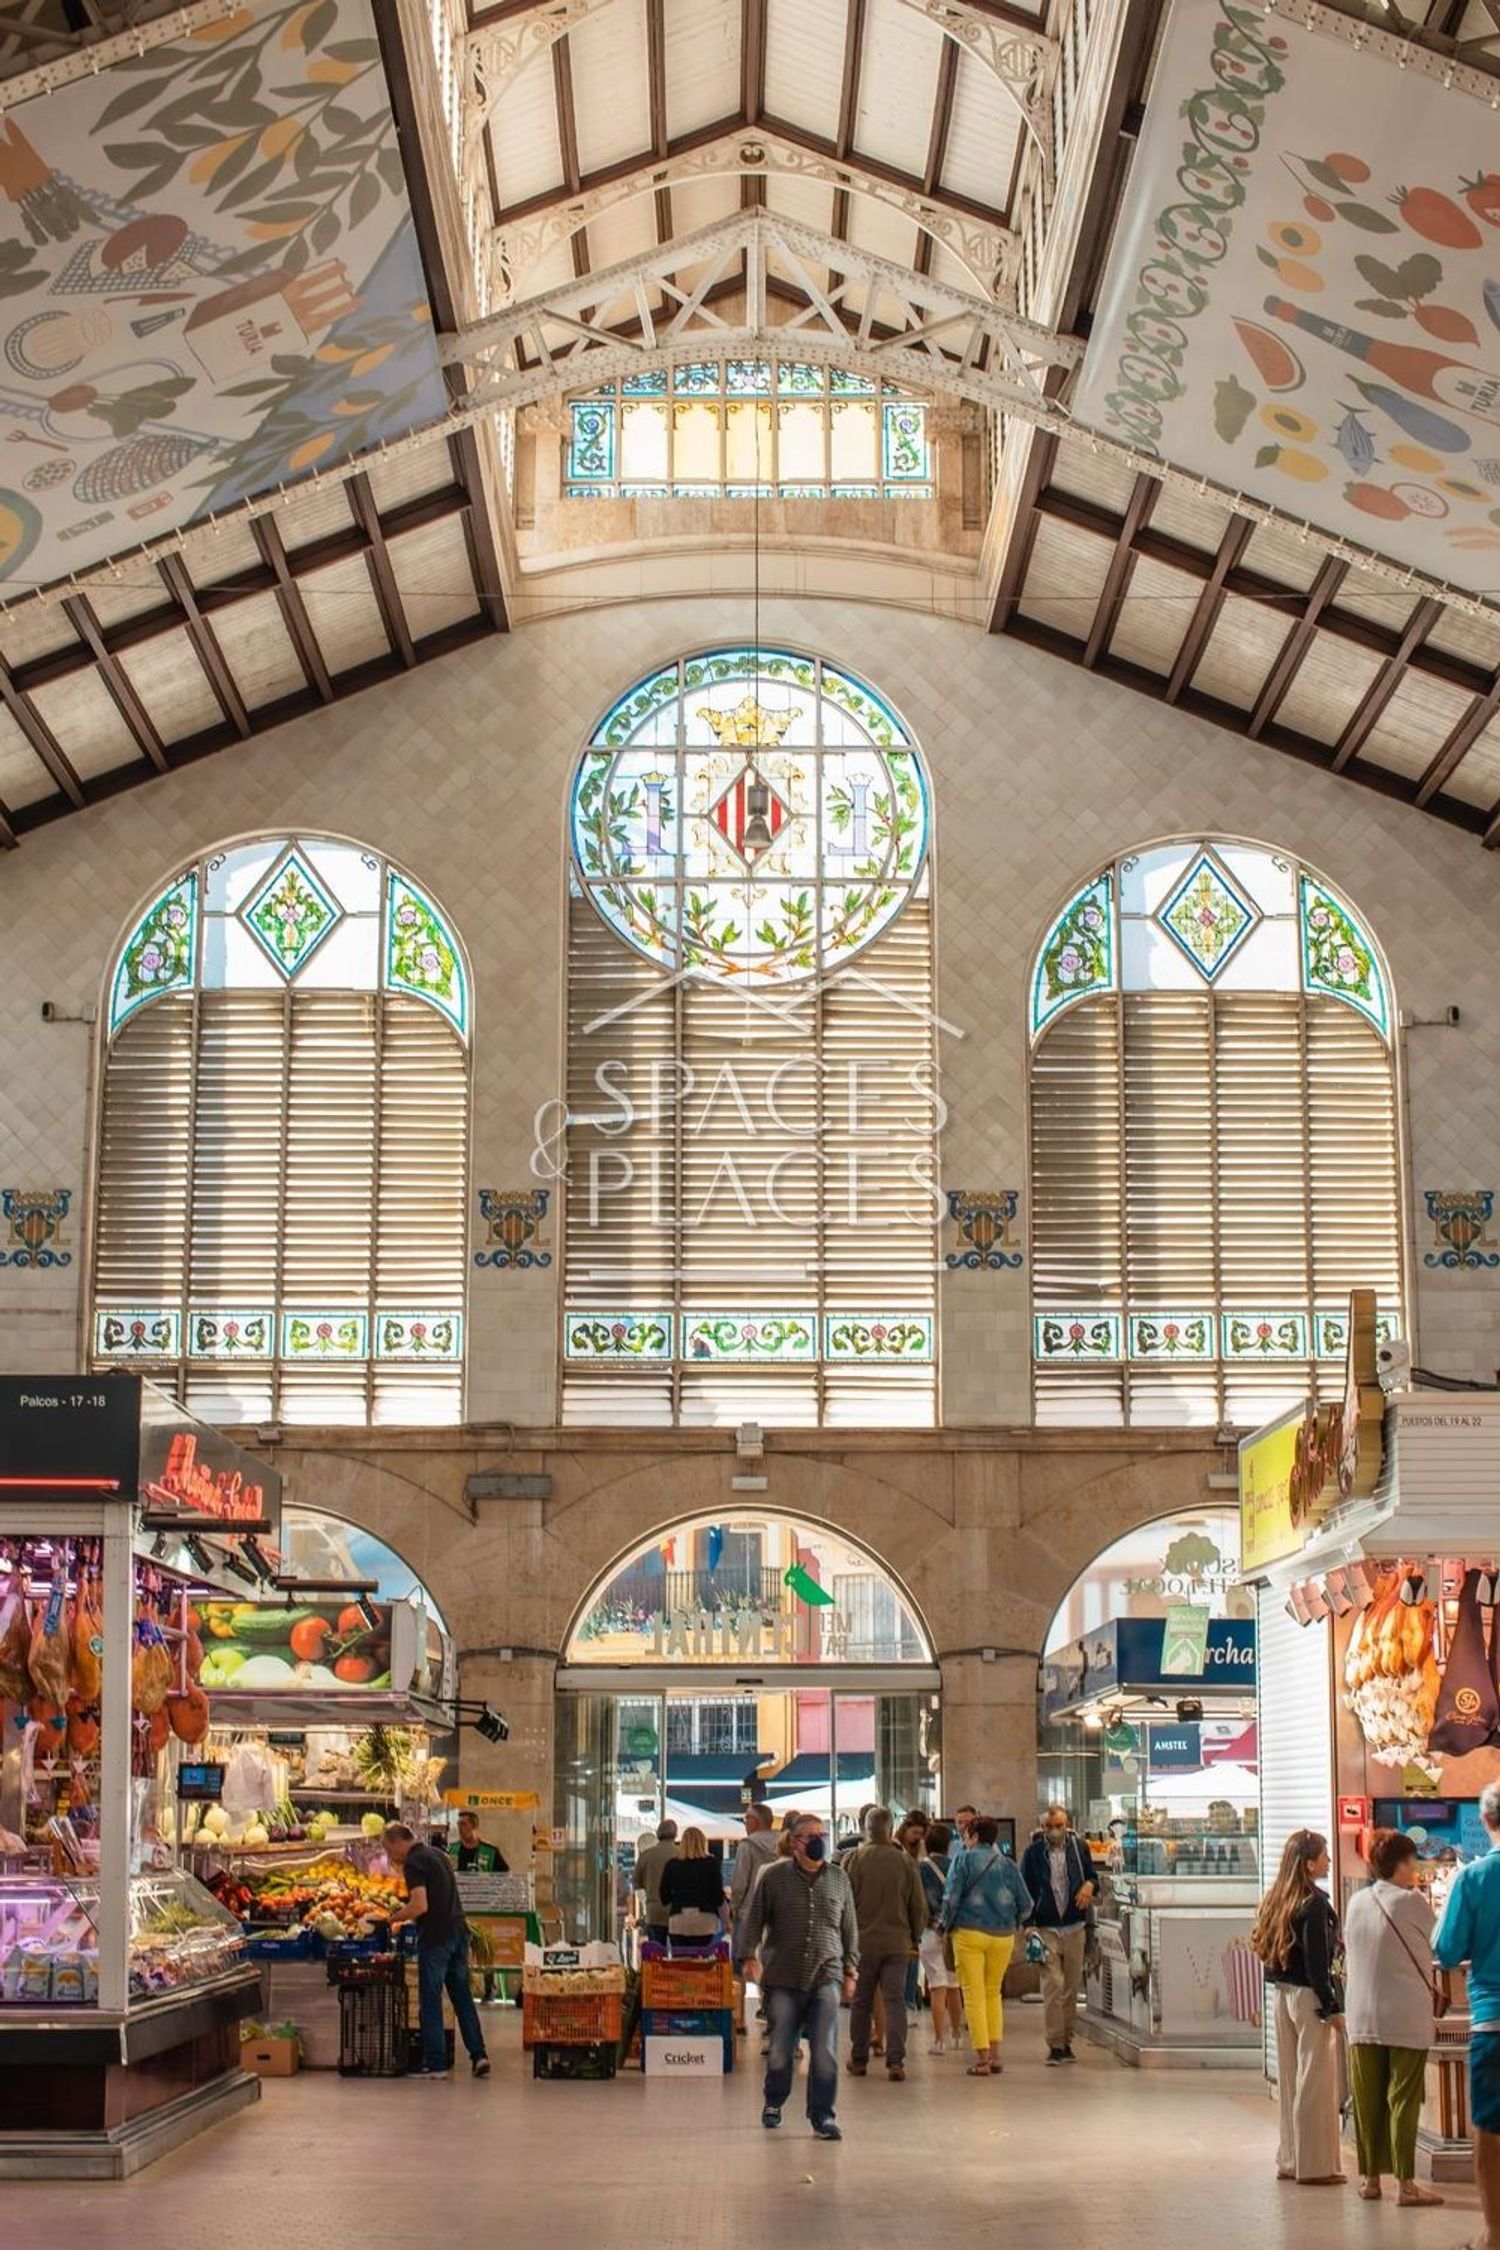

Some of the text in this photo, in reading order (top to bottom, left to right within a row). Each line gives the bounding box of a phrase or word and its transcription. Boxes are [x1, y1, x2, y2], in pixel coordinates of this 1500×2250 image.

[236, 319, 263, 357] TURIA
[1471, 380, 1500, 414] TURIA
[20, 1394, 58, 1407] Palcos
[70, 1394, 84, 1407] 17
[481, 1796, 514, 1806] ONCE
[664, 2052, 705, 2065] Cricket
